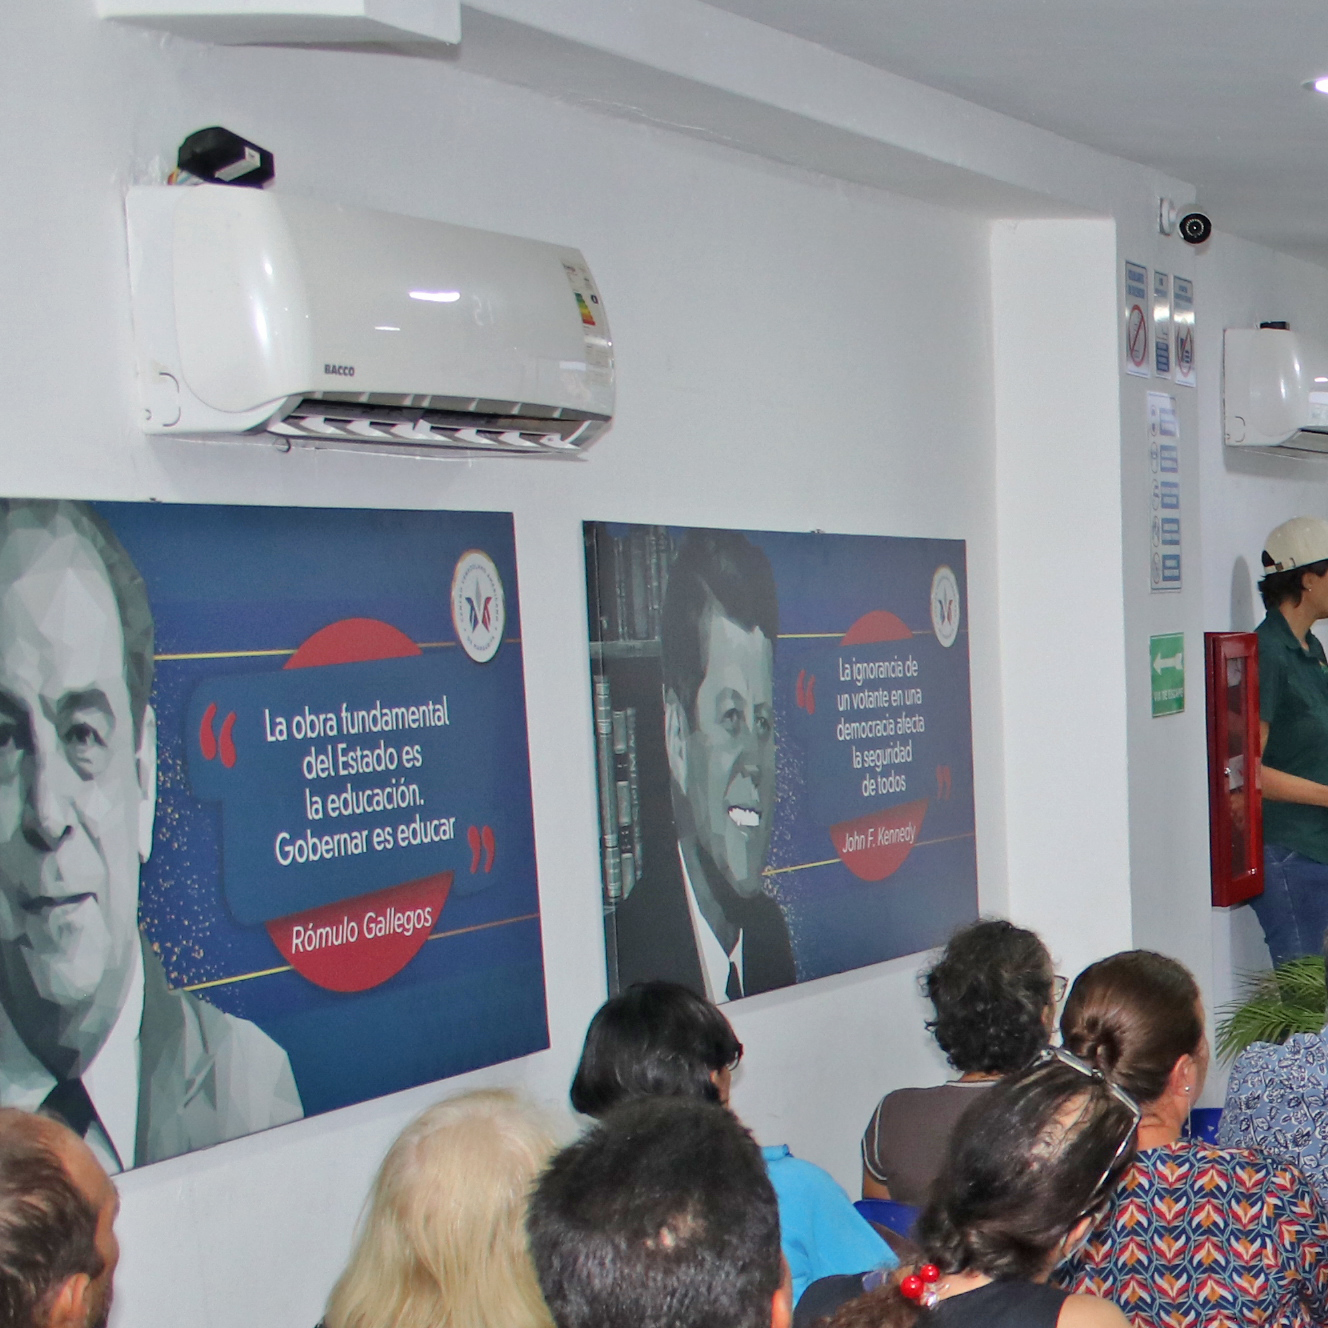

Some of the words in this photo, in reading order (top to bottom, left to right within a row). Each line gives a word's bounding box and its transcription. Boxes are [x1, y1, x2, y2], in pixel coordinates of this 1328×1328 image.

[324, 363, 355, 377] BACCO
[839, 657, 851, 681] La
[852, 655, 903, 686] ignorancia
[905, 655, 918, 677] de
[837, 693, 850, 711] un
[852, 686, 889, 710] votante
[891, 689, 903, 707] en
[905, 688, 922, 706] una
[264, 709, 287, 742] La
[292, 706, 337, 739] obra
[340, 695, 450, 735] fundamental
[837, 714, 894, 741] democracia
[897, 712, 925, 734] afecta
[303, 745, 335, 780] del
[338, 739, 398, 776] Estado
[402, 744, 423, 769] es
[852, 745, 862, 769] la
[864, 739, 912, 772] seguridad
[306, 788, 323, 820] la
[327, 777, 425, 816] educación.
[862, 773, 876, 797] de
[877, 769, 906, 795] todos
[275, 829, 368, 866] Gobernar
[373, 826, 393, 851] es
[397, 814, 456, 847] educar
[842, 830, 865, 853] John
[867, 827, 876, 848] F.
[877, 821, 916, 845] Kennedy
[292, 916, 358, 954] Rómulo
[363, 906, 433, 937] Gallegos
